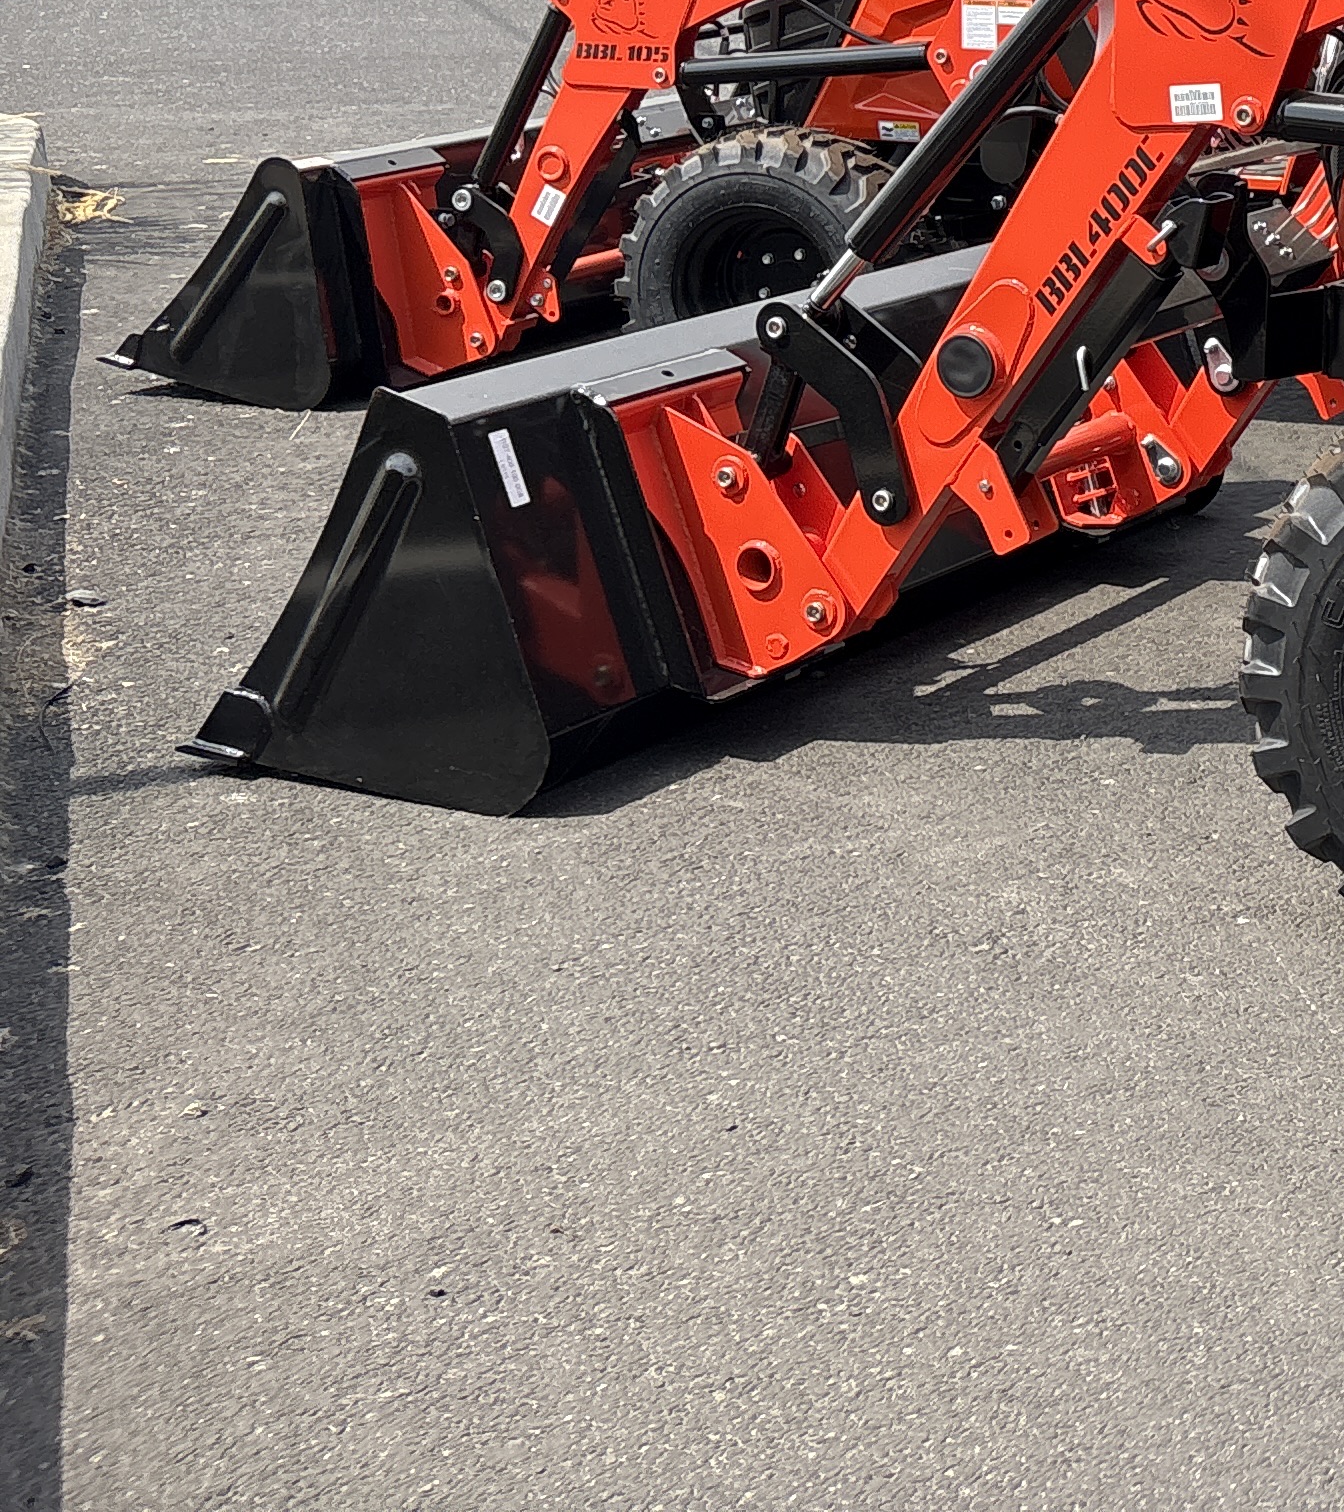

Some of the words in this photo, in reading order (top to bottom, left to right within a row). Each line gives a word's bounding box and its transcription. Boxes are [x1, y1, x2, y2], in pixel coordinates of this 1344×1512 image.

[576, 42, 623, 61] BBL
[627, 44, 669, 63] 105
[1034, 241, 1098, 317] BBL
